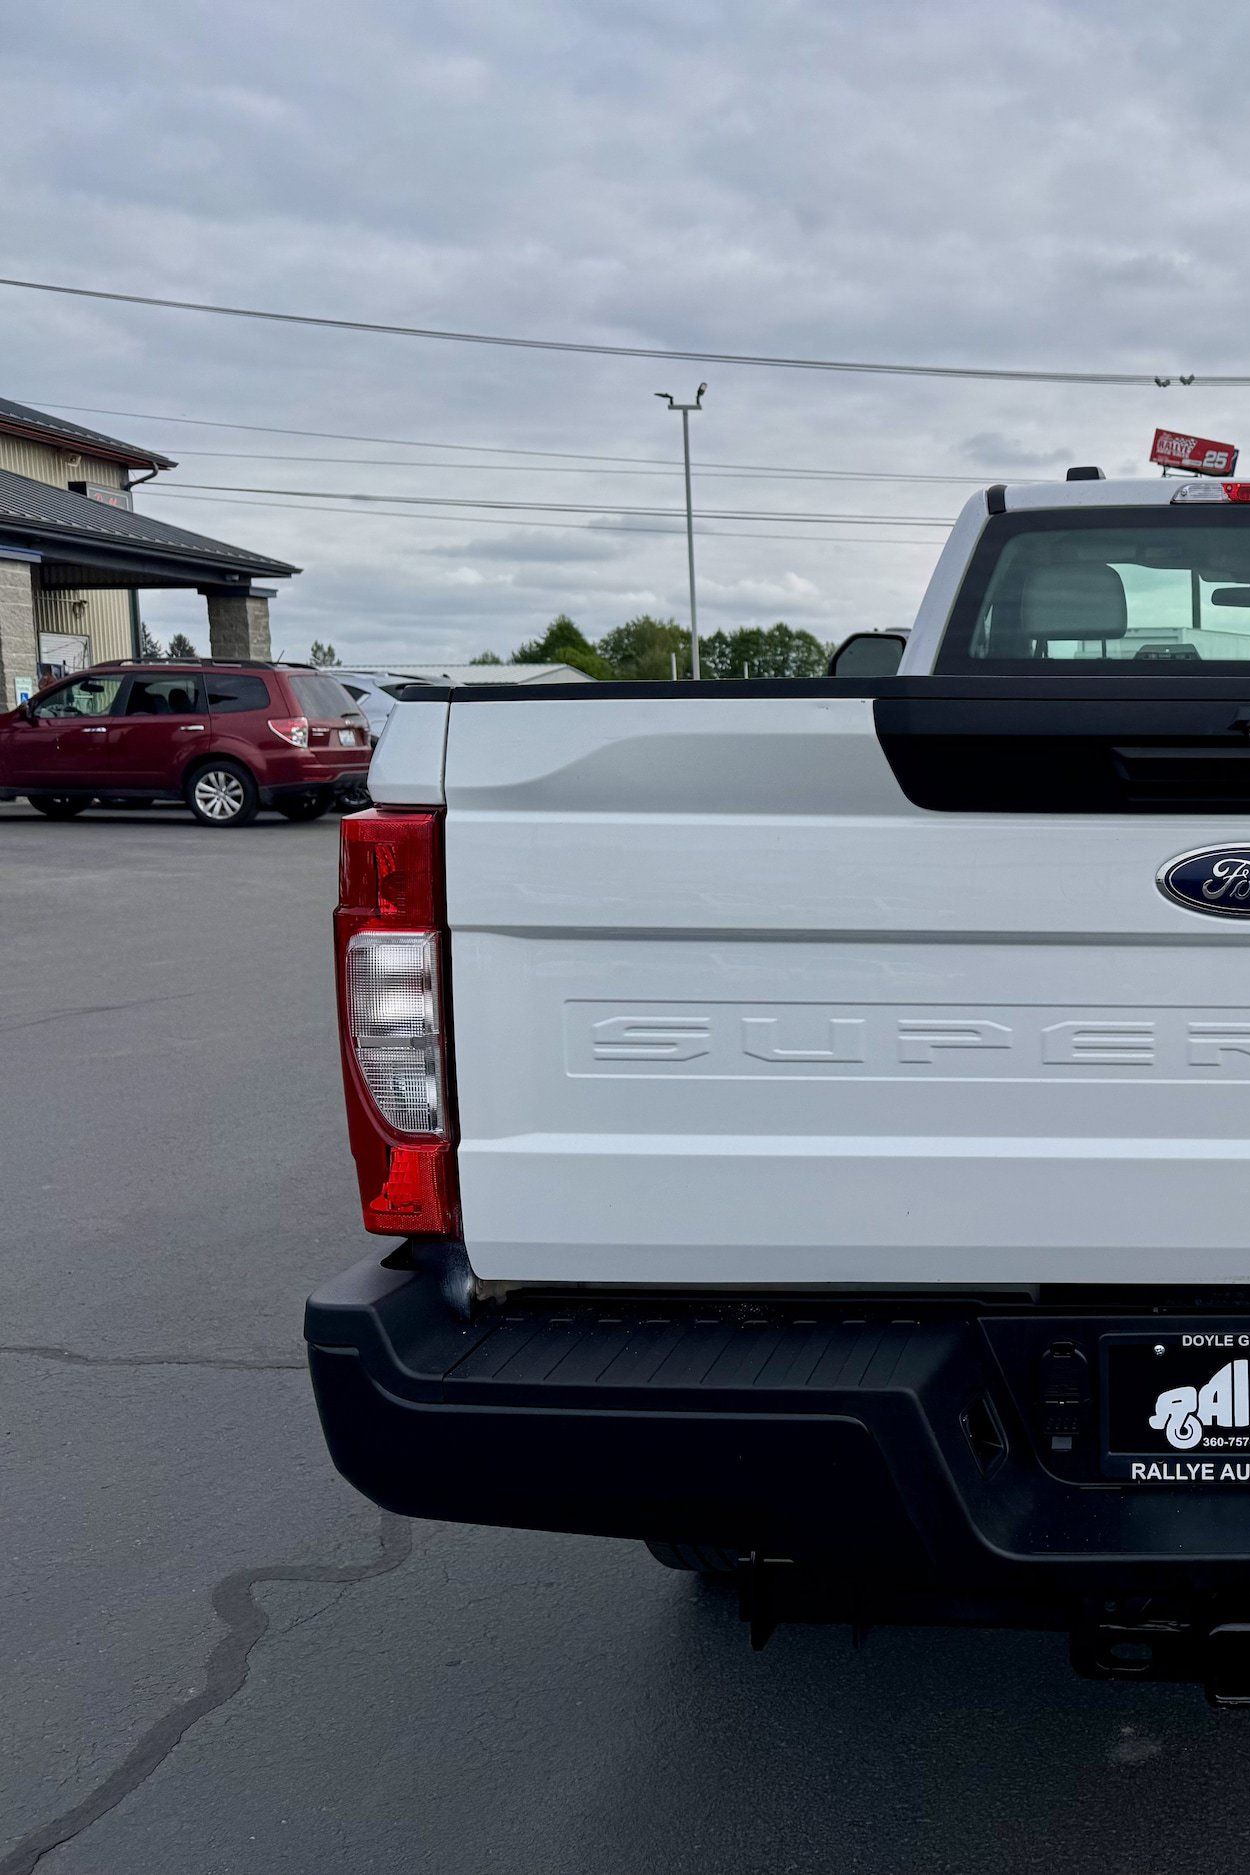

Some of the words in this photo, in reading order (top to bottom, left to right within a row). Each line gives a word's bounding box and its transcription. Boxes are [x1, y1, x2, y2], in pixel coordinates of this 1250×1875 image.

[1203, 450, 1228, 469] 25
[1182, 1335, 1234, 1347] DOYLE
[1131, 1463, 1215, 1481] RALLYE
